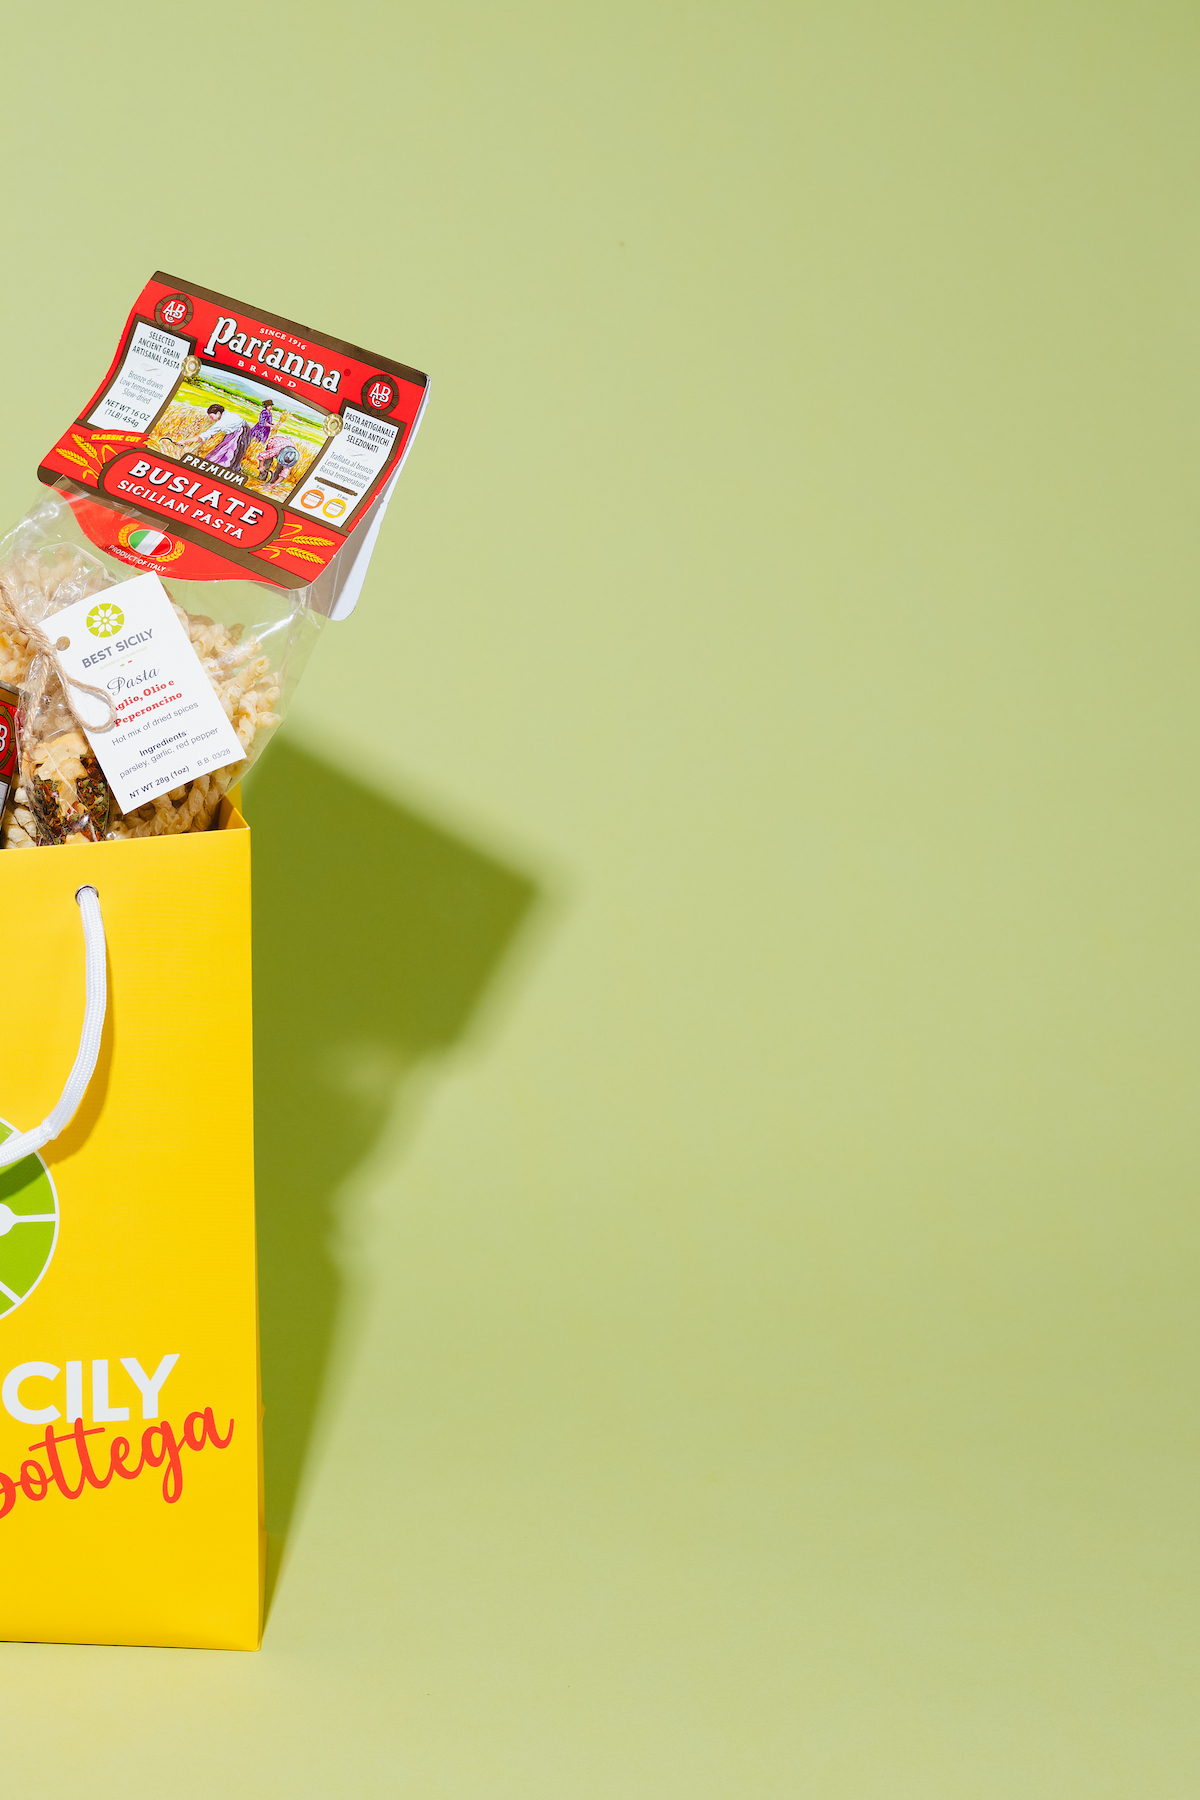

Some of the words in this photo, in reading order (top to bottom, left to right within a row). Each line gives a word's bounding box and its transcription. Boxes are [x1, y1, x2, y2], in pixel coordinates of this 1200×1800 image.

[138, 337, 162, 354] ANCIENT
[162, 346, 180, 360] GRAIN
[150, 332, 176, 347] SELECTED
[260, 327, 286, 341] SINCE
[288, 336, 307, 350] 1916
[132, 346, 162, 365] ARTISANAL
[163, 357, 180, 370] PASTA
[204, 316, 342, 394] Partanna
[128, 370, 146, 383] Bronze
[146, 377, 164, 390] drawn
[238, 360, 297, 388] BRAND
[120, 377, 129, 387] Low
[130, 381, 164, 400] temperature
[104, 408, 122, 422] (1LB)
[123, 415, 140, 428] 454g
[106, 398, 120, 410] NET
[120, 404, 131, 412] WT
[130, 408, 139, 416] 16
[140, 412, 150, 422] OZ
[91, 434, 124, 442] CLASSIC
[125, 434, 142, 443] CUT
[344, 422, 352, 432] DA
[351, 426, 368, 438] GRANI
[368, 432, 390, 446] ANTICHI
[345, 414, 360, 426] PASTA
[360, 418, 396, 439] ARTIGIANALE
[346, 434, 380, 454] SELEZIONATI
[182, 454, 245, 486] PREMIUM
[128, 459, 264, 526] BUSIATE
[117, 480, 191, 514] SICILIAN
[191, 510, 245, 540] PASTA
[109, 544, 139, 563] PRODUCT
[137, 558, 148, 568] OF
[147, 562, 166, 573] ITALY
[81, 646, 112, 668] BEST
[116, 628, 154, 652] SICILY
[106, 667, 160, 696] Pasta
[143, 682, 167, 697] Olio
[114, 692, 182, 728] Peperoncino
[112, 734, 126, 746] Hot
[127, 728, 142, 740] mix
[142, 722, 152, 732] of
[152, 711, 172, 729] dried
[173, 702, 199, 722] spices
[119, 758, 150, 779] parsley,
[150, 746, 175, 766] garlic,
[175, 739, 190, 751] red
[190, 727, 220, 748] pepper
[139, 730, 189, 757] Ingredients:
[129, 788, 143, 800] NT
[141, 782, 156, 794] WT
[156, 774, 170, 788] 28g
[170, 765, 190, 780] (1oz)
